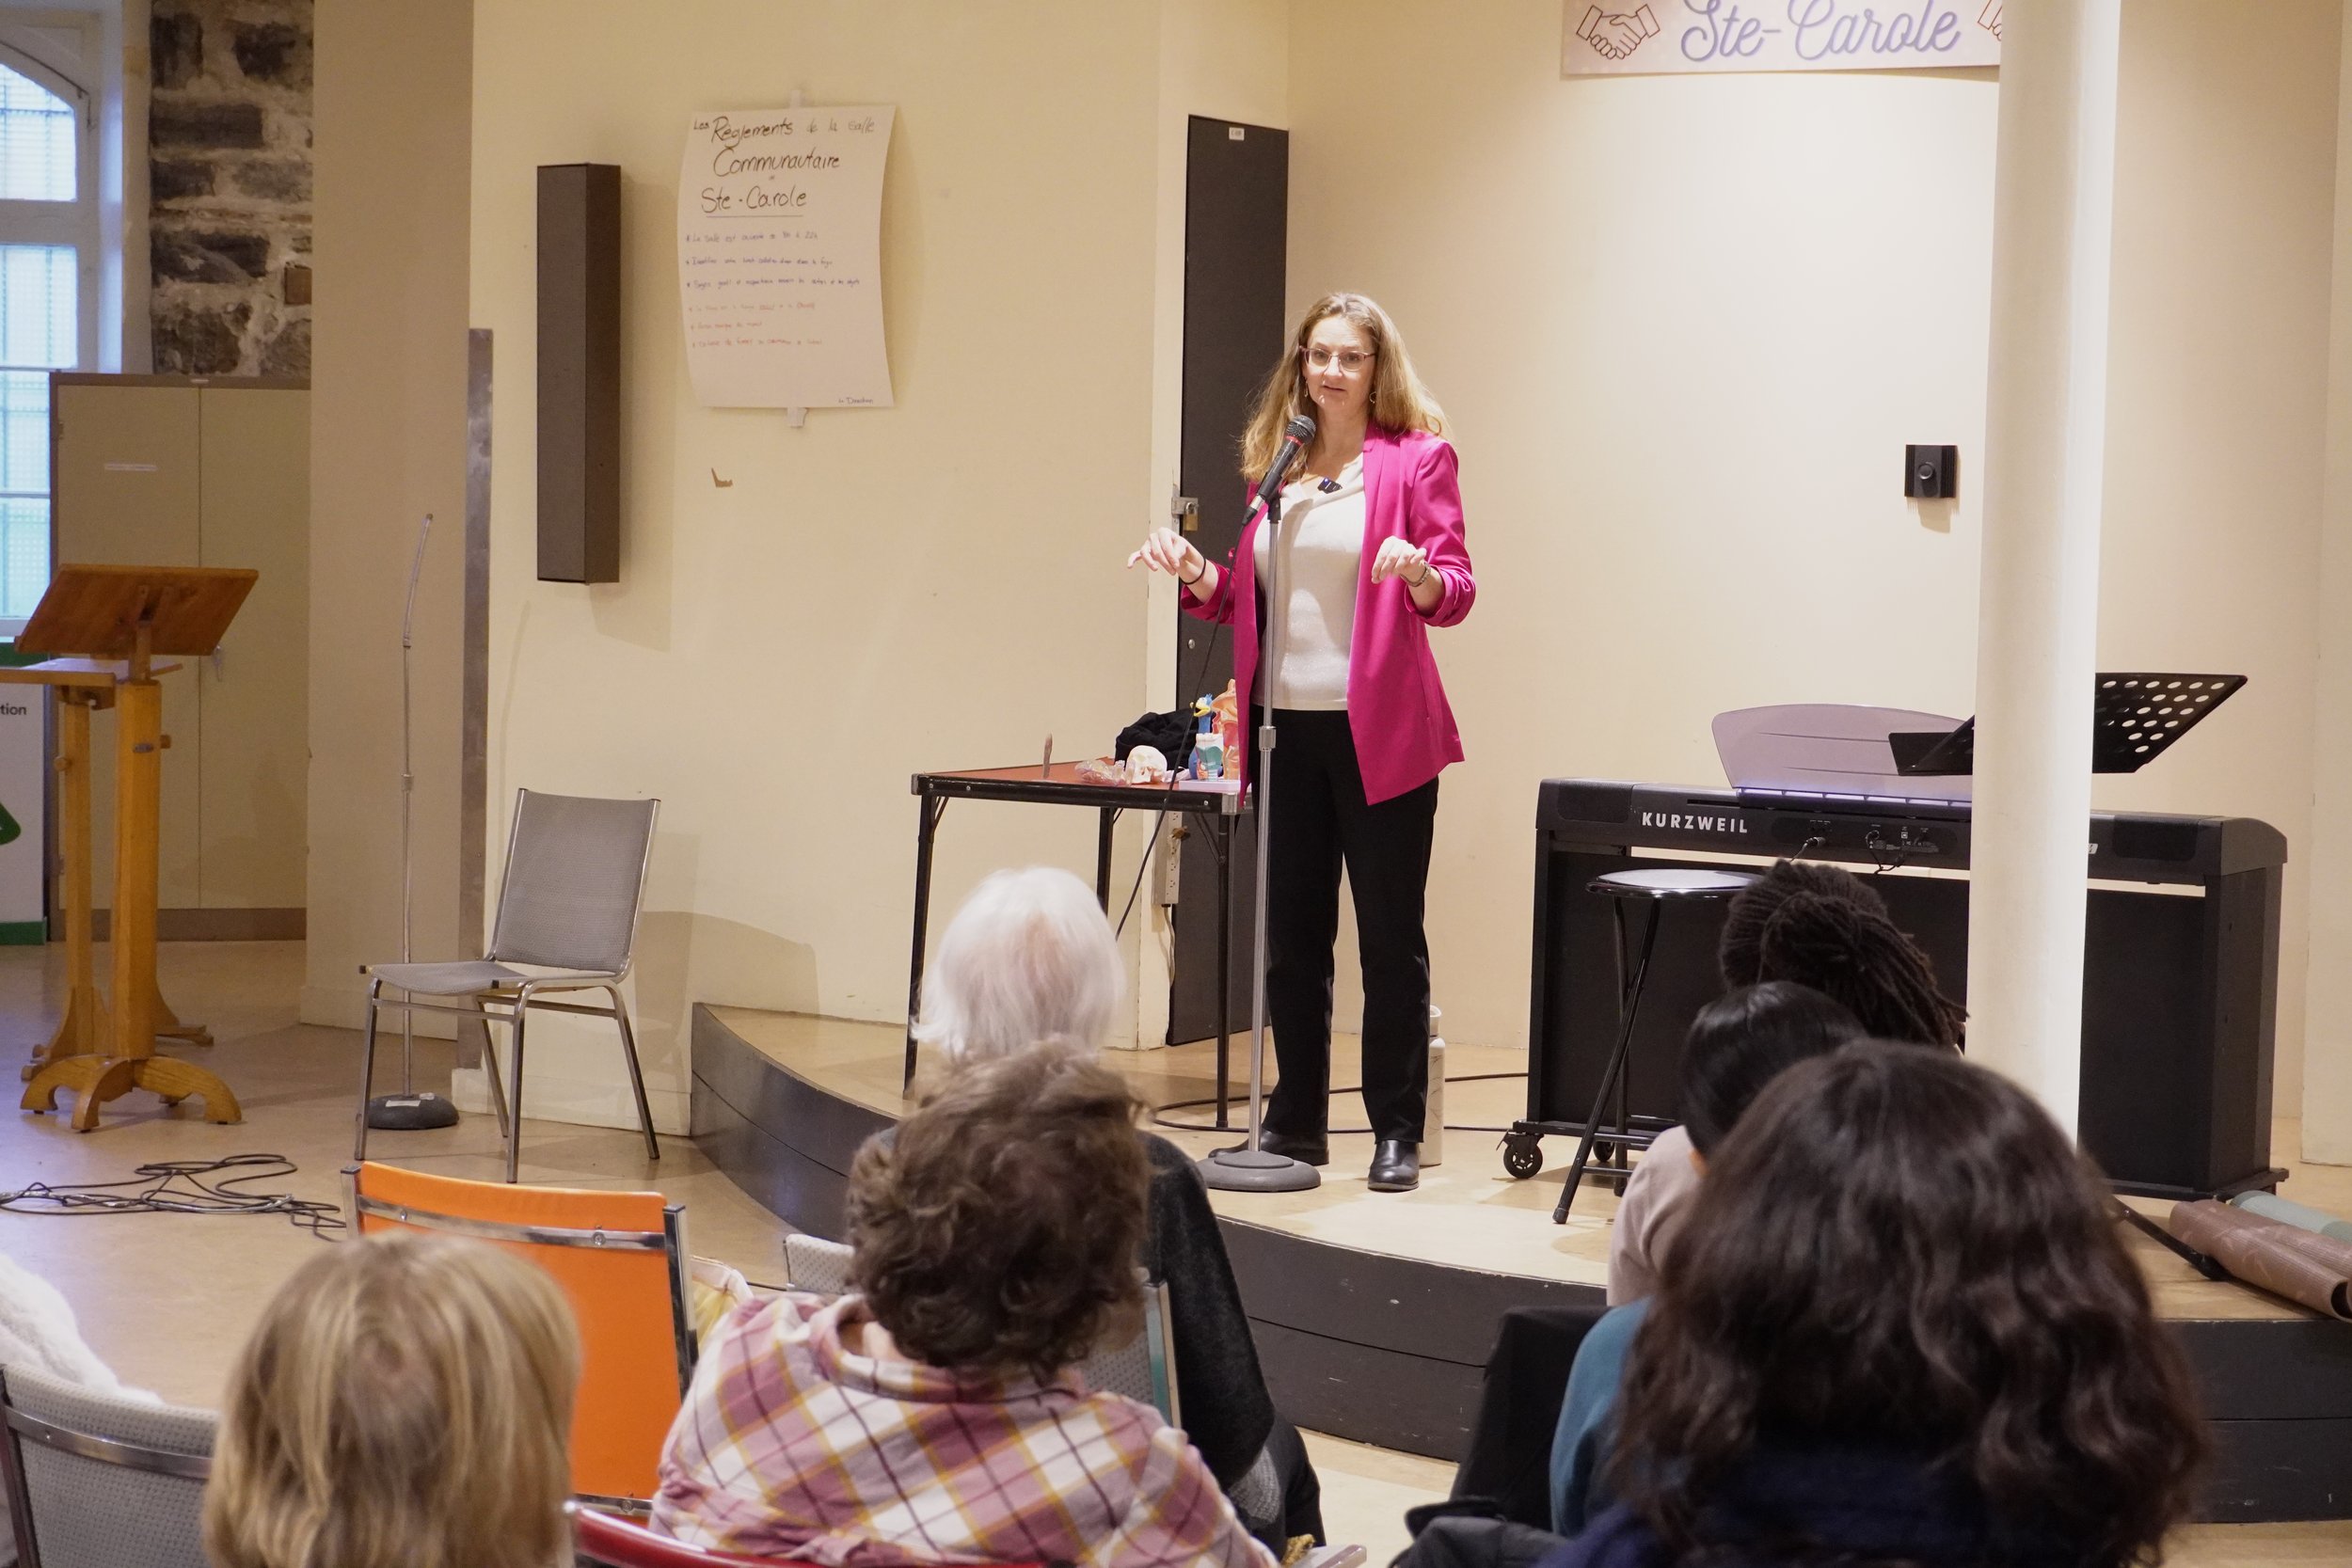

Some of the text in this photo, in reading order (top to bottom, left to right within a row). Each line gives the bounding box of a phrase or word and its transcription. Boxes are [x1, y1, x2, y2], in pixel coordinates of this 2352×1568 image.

[1681, 0, 1962, 62] Ste-Carole
[713, 147, 840, 177] Communautaire
[1642, 812, 1748, 833] KURZWEIL
